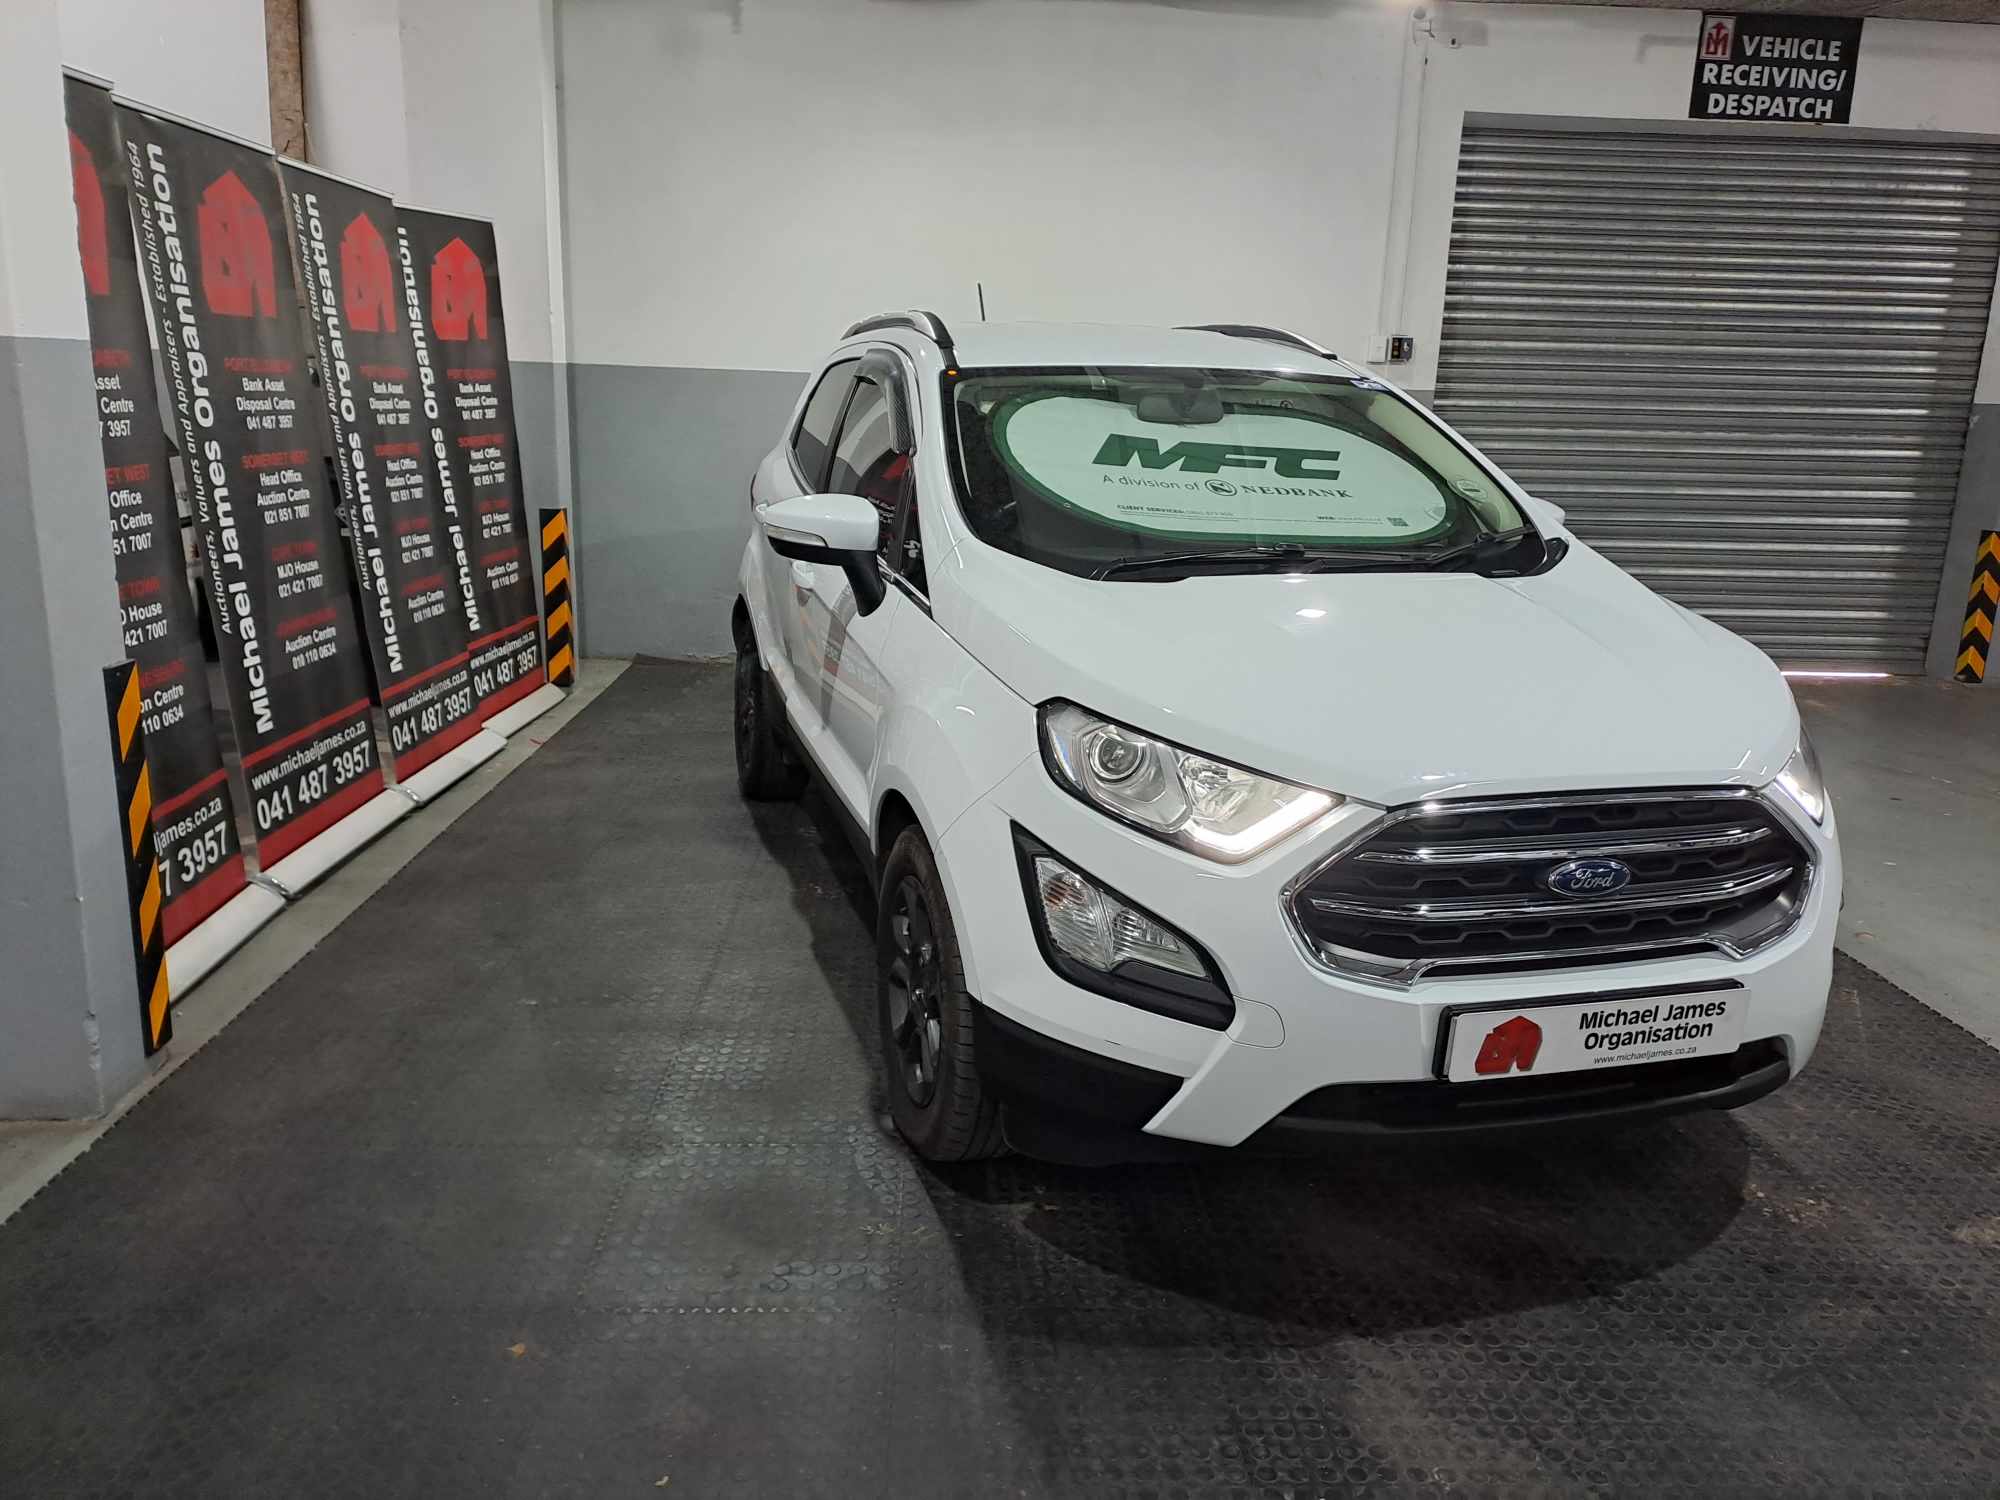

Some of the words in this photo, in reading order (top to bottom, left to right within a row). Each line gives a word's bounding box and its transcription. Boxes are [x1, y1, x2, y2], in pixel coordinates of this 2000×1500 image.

[1742, 35, 1842, 62] VEHICLE
[1702, 63, 1848, 91] RECEIVING/
[1707, 93, 1833, 119] DESPATCH
[127, 140, 146, 188] 1964
[136, 193, 168, 303] Established
[146, 142, 215, 428] Organisation
[305, 193, 356, 422] Organisation
[163, 318, 190, 415] Appraisers
[101, 397, 135, 414] Centre
[236, 396, 273, 414] Disposal
[107, 420, 131, 437] 3957
[180, 418, 197, 453] and
[330, 413, 343, 443] and
[431, 427, 458, 518] James
[1091, 433, 1341, 480] MFC
[110, 490, 142, 508] Office
[190, 459, 211, 523] Valuers
[257, 491, 286, 506] Auction
[348, 431, 378, 538] James
[1103, 474, 1114, 484] A
[1119, 475, 1179, 489] division
[1186, 482, 1200, 491] of
[1241, 485, 1353, 498] NEDBANK
[121, 512, 153, 530] Centre
[204, 439, 244, 571] James
[113, 537, 127, 555] 51
[129, 532, 151, 552] 7007
[205, 528, 233, 635] Auctioneers,
[449, 525, 481, 631] Michael
[129, 603, 162, 623] House
[368, 548, 404, 673] Michael
[125, 628, 144, 648] 421
[146, 620, 168, 640] 7007
[285, 634, 313, 654] Auction
[313, 626, 336, 642] Centre
[228, 581, 274, 734] Michael
[473, 668, 496, 697] 041
[496, 659, 514, 686] 487
[516, 645, 538, 674] 3957
[154, 684, 184, 707] Centre
[141, 714, 160, 736] 110
[162, 704, 184, 727] 0634
[392, 717, 419, 750] 041
[421, 702, 443, 734] 487
[444, 687, 472, 721] 3957
[252, 720, 366, 791] www.michaeljames.co.za
[257, 785, 293, 829] 041
[298, 764, 328, 803] 487
[333, 740, 369, 784] 3957
[153, 797, 223, 856] ljames.co.za
[178, 820, 227, 882] 3957
[1570, 868, 1615, 889] Ford
[1579, 1005, 1659, 1030] Michael
[1663, 1001, 1726, 1022] James
[1584, 1022, 1713, 1050] Organisation
[1594, 1047, 1697, 1064] www.michaeljames.co.za
